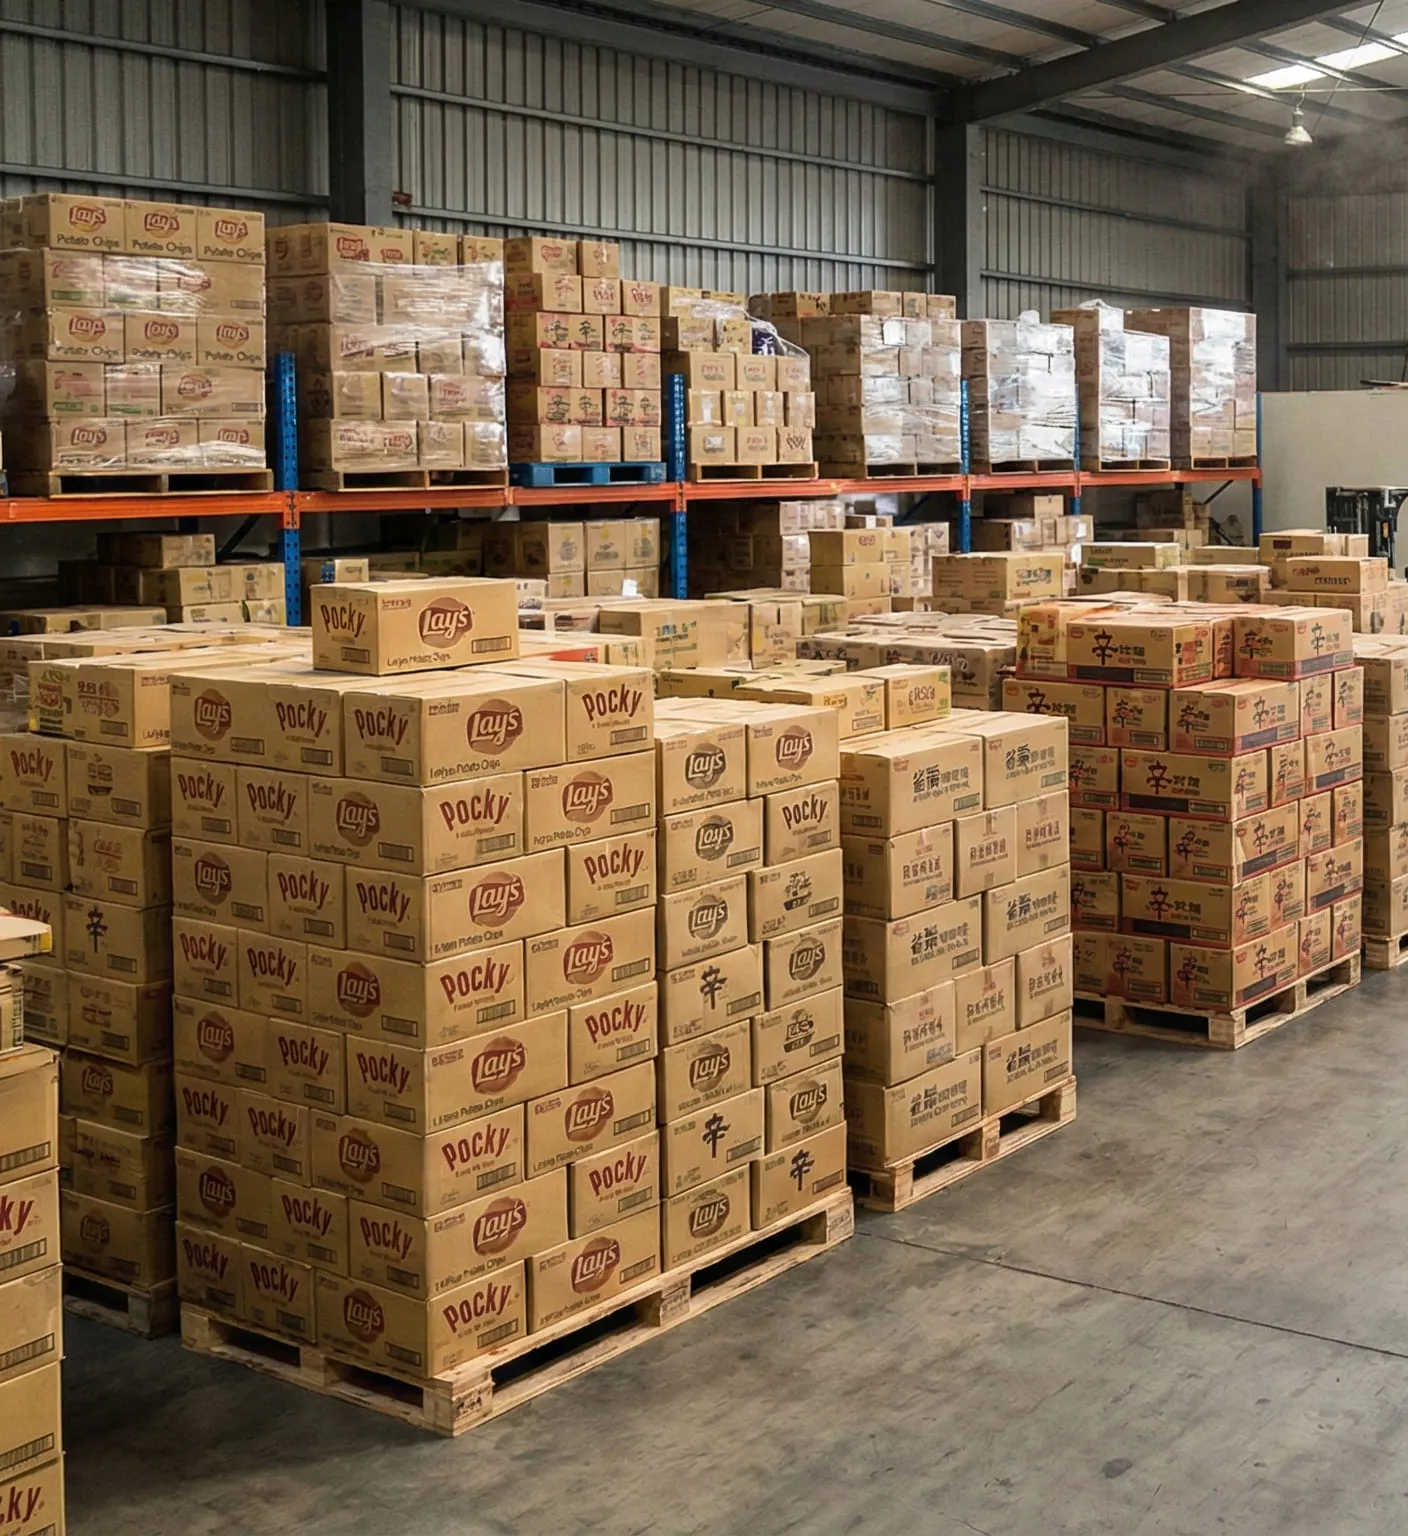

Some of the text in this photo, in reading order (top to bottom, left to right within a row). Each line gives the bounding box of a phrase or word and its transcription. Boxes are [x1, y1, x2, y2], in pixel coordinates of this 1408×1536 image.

[320, 601, 367, 638] Pocky
[276, 700, 327, 737] Pocky
[582, 684, 643, 721] Pocky
[355, 706, 409, 745] Pocky
[10, 749, 53, 785] Pocky
[178, 773, 225, 808] Pocky
[247, 782, 296, 819] Pocky
[440, 788, 510, 832] Pocky
[781, 794, 828, 830] Pocky
[584, 843, 644, 883] Pocky
[277, 870, 329, 910] Pocky
[357, 882, 410, 923] Pocky
[180, 933, 226, 970] Pocky
[247, 947, 296, 986] Pocky
[440, 958, 510, 1004] Pocky
[585, 1000, 646, 1044] Pocky
[279, 1036, 329, 1076] Pocky
[357, 1053, 410, 1094] Pocky
[183, 1087, 229, 1126] Pocky
[248, 1107, 296, 1146] Pocky
[442, 1123, 510, 1171] Pocky
[589, 1152, 647, 1196] Pocky
[281, 1194, 332, 1236] Pocky
[360, 1217, 412, 1260] Pocky
[251, 1263, 298, 1302] Pocky
[443, 1282, 511, 1334] Pocky
